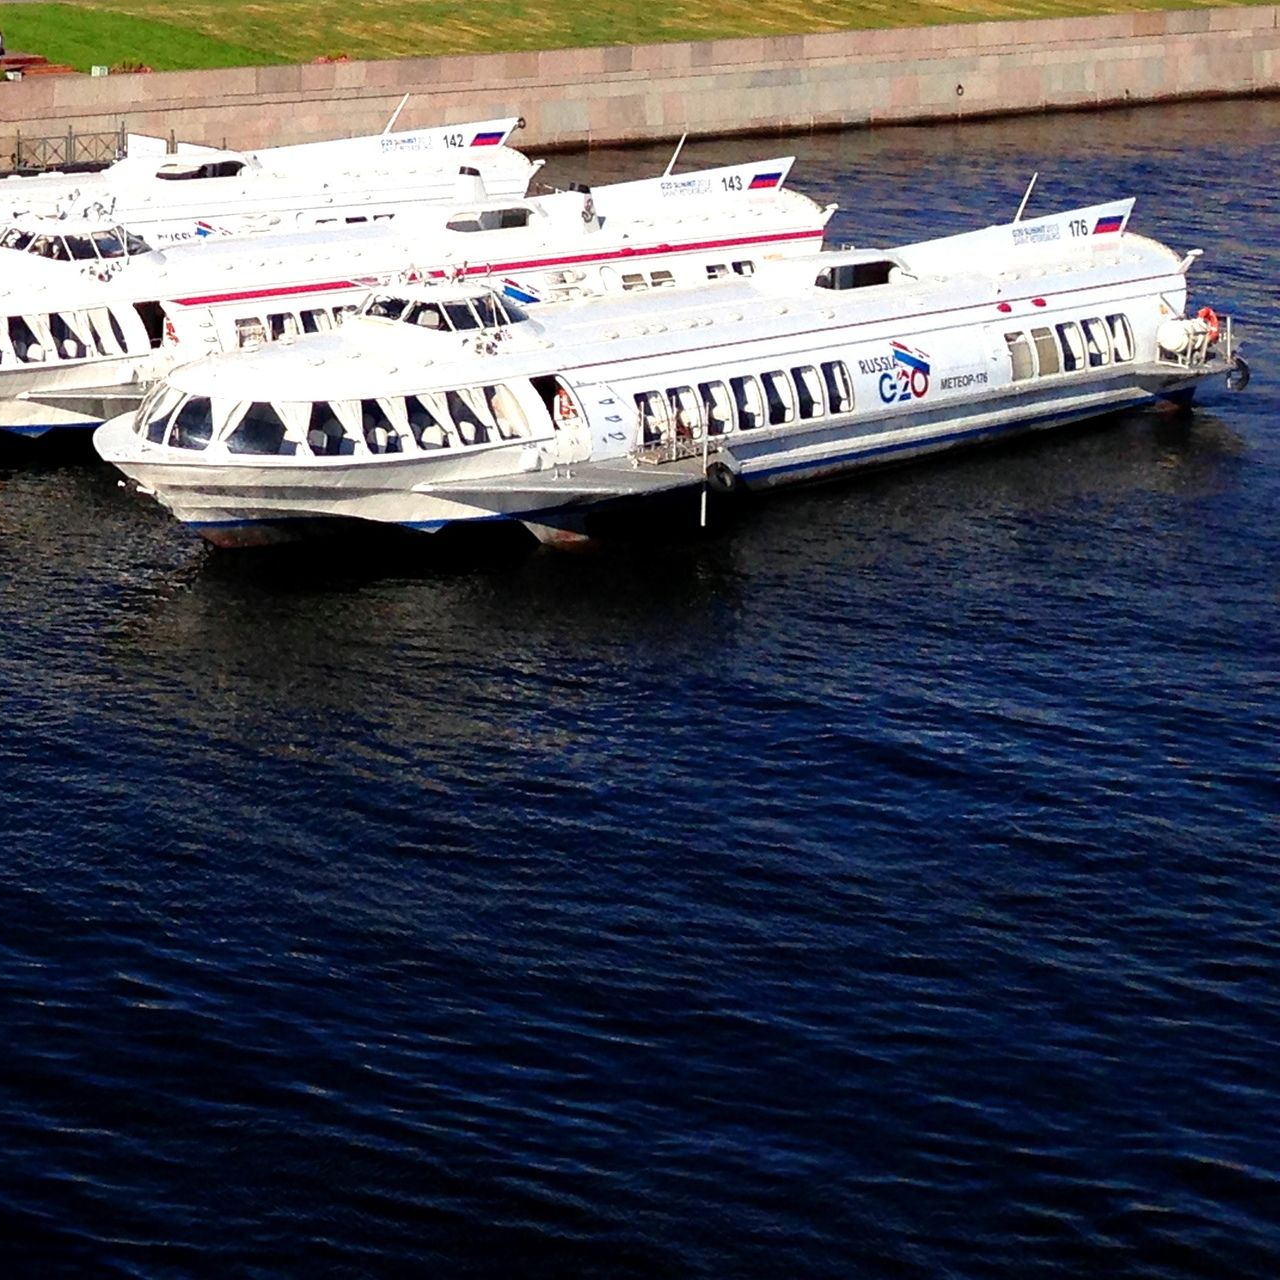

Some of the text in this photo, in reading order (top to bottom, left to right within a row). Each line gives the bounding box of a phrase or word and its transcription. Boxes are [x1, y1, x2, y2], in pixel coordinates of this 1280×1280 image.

[443, 133, 465, 149] 142
[721, 175, 743, 192] 143
[1068, 219, 1089, 237] 176
[858, 354, 900, 375] RUSSIA
[879, 367, 928, 403] G20
